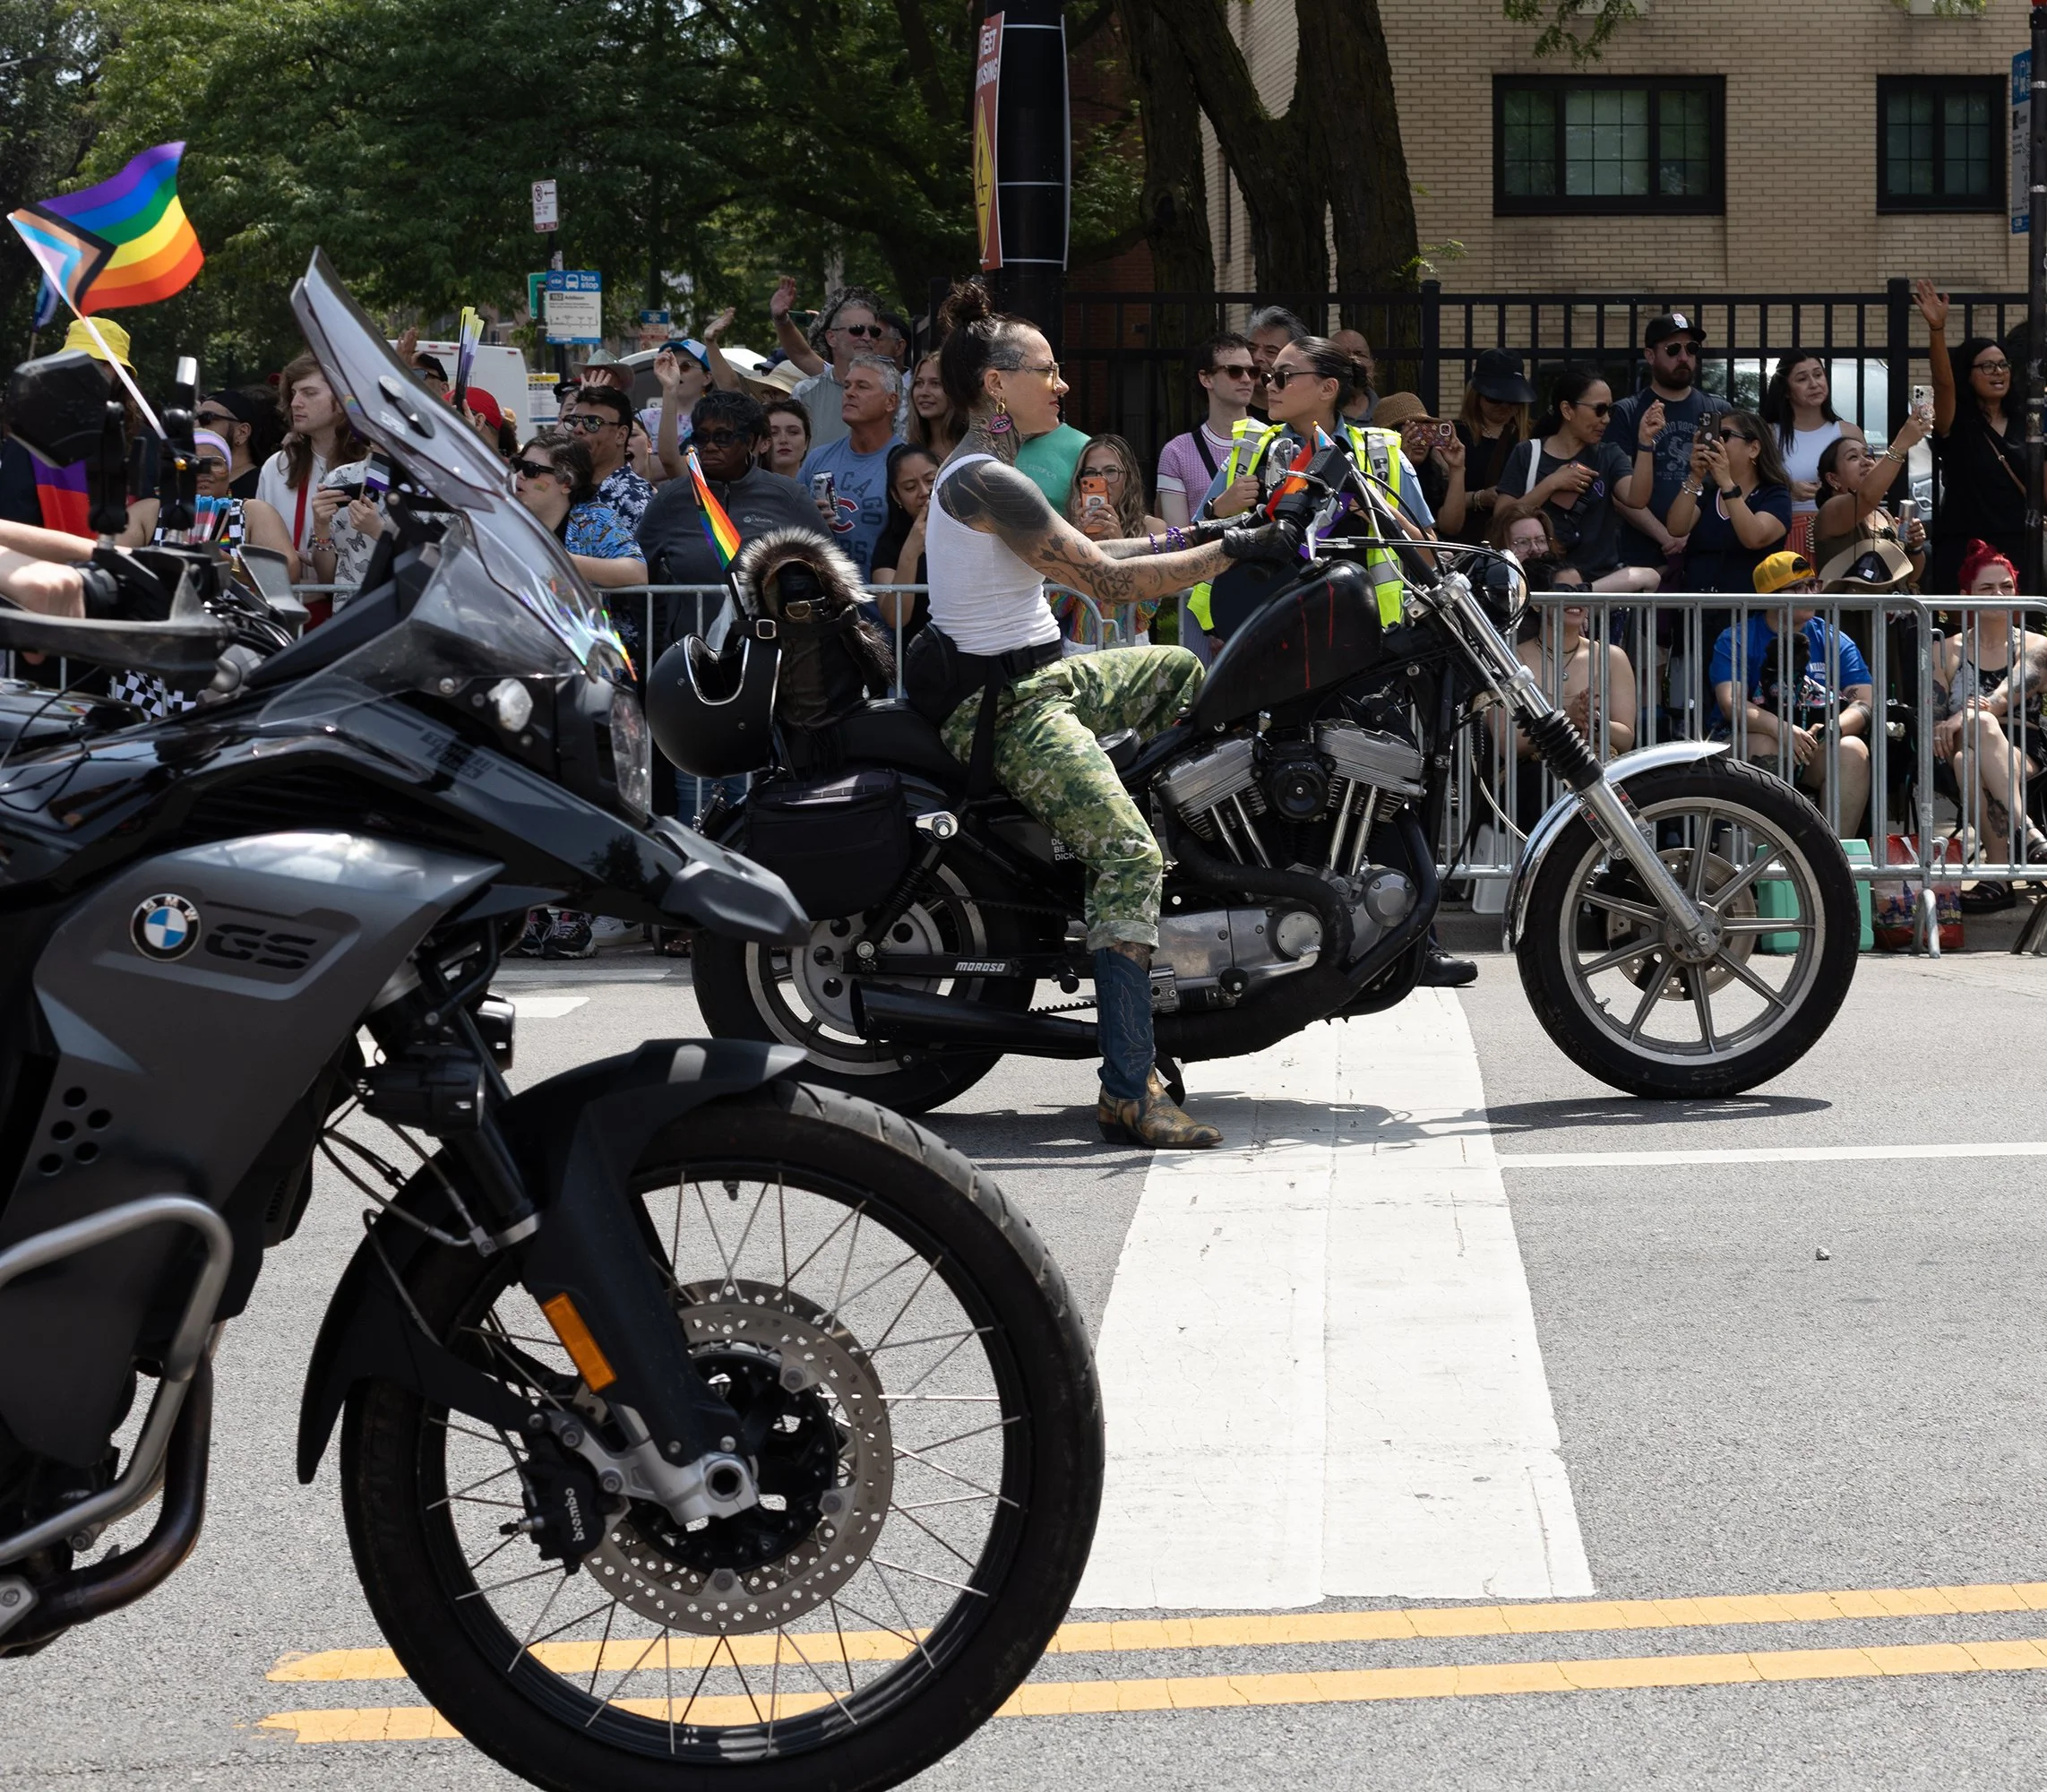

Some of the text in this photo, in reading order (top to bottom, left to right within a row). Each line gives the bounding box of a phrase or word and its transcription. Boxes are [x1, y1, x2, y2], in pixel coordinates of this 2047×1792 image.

[581, 274, 596, 282] bus
[581, 281, 598, 290] stop
[840, 471, 883, 526] CAGO
[1054, 845, 1066, 853] BE
[1054, 852, 1076, 861] DICK
[142, 895, 199, 922] BMW
[204, 924, 317, 969] GS
[954, 961, 1006, 972] MOROSO
[564, 1487, 585, 1542] brembo
